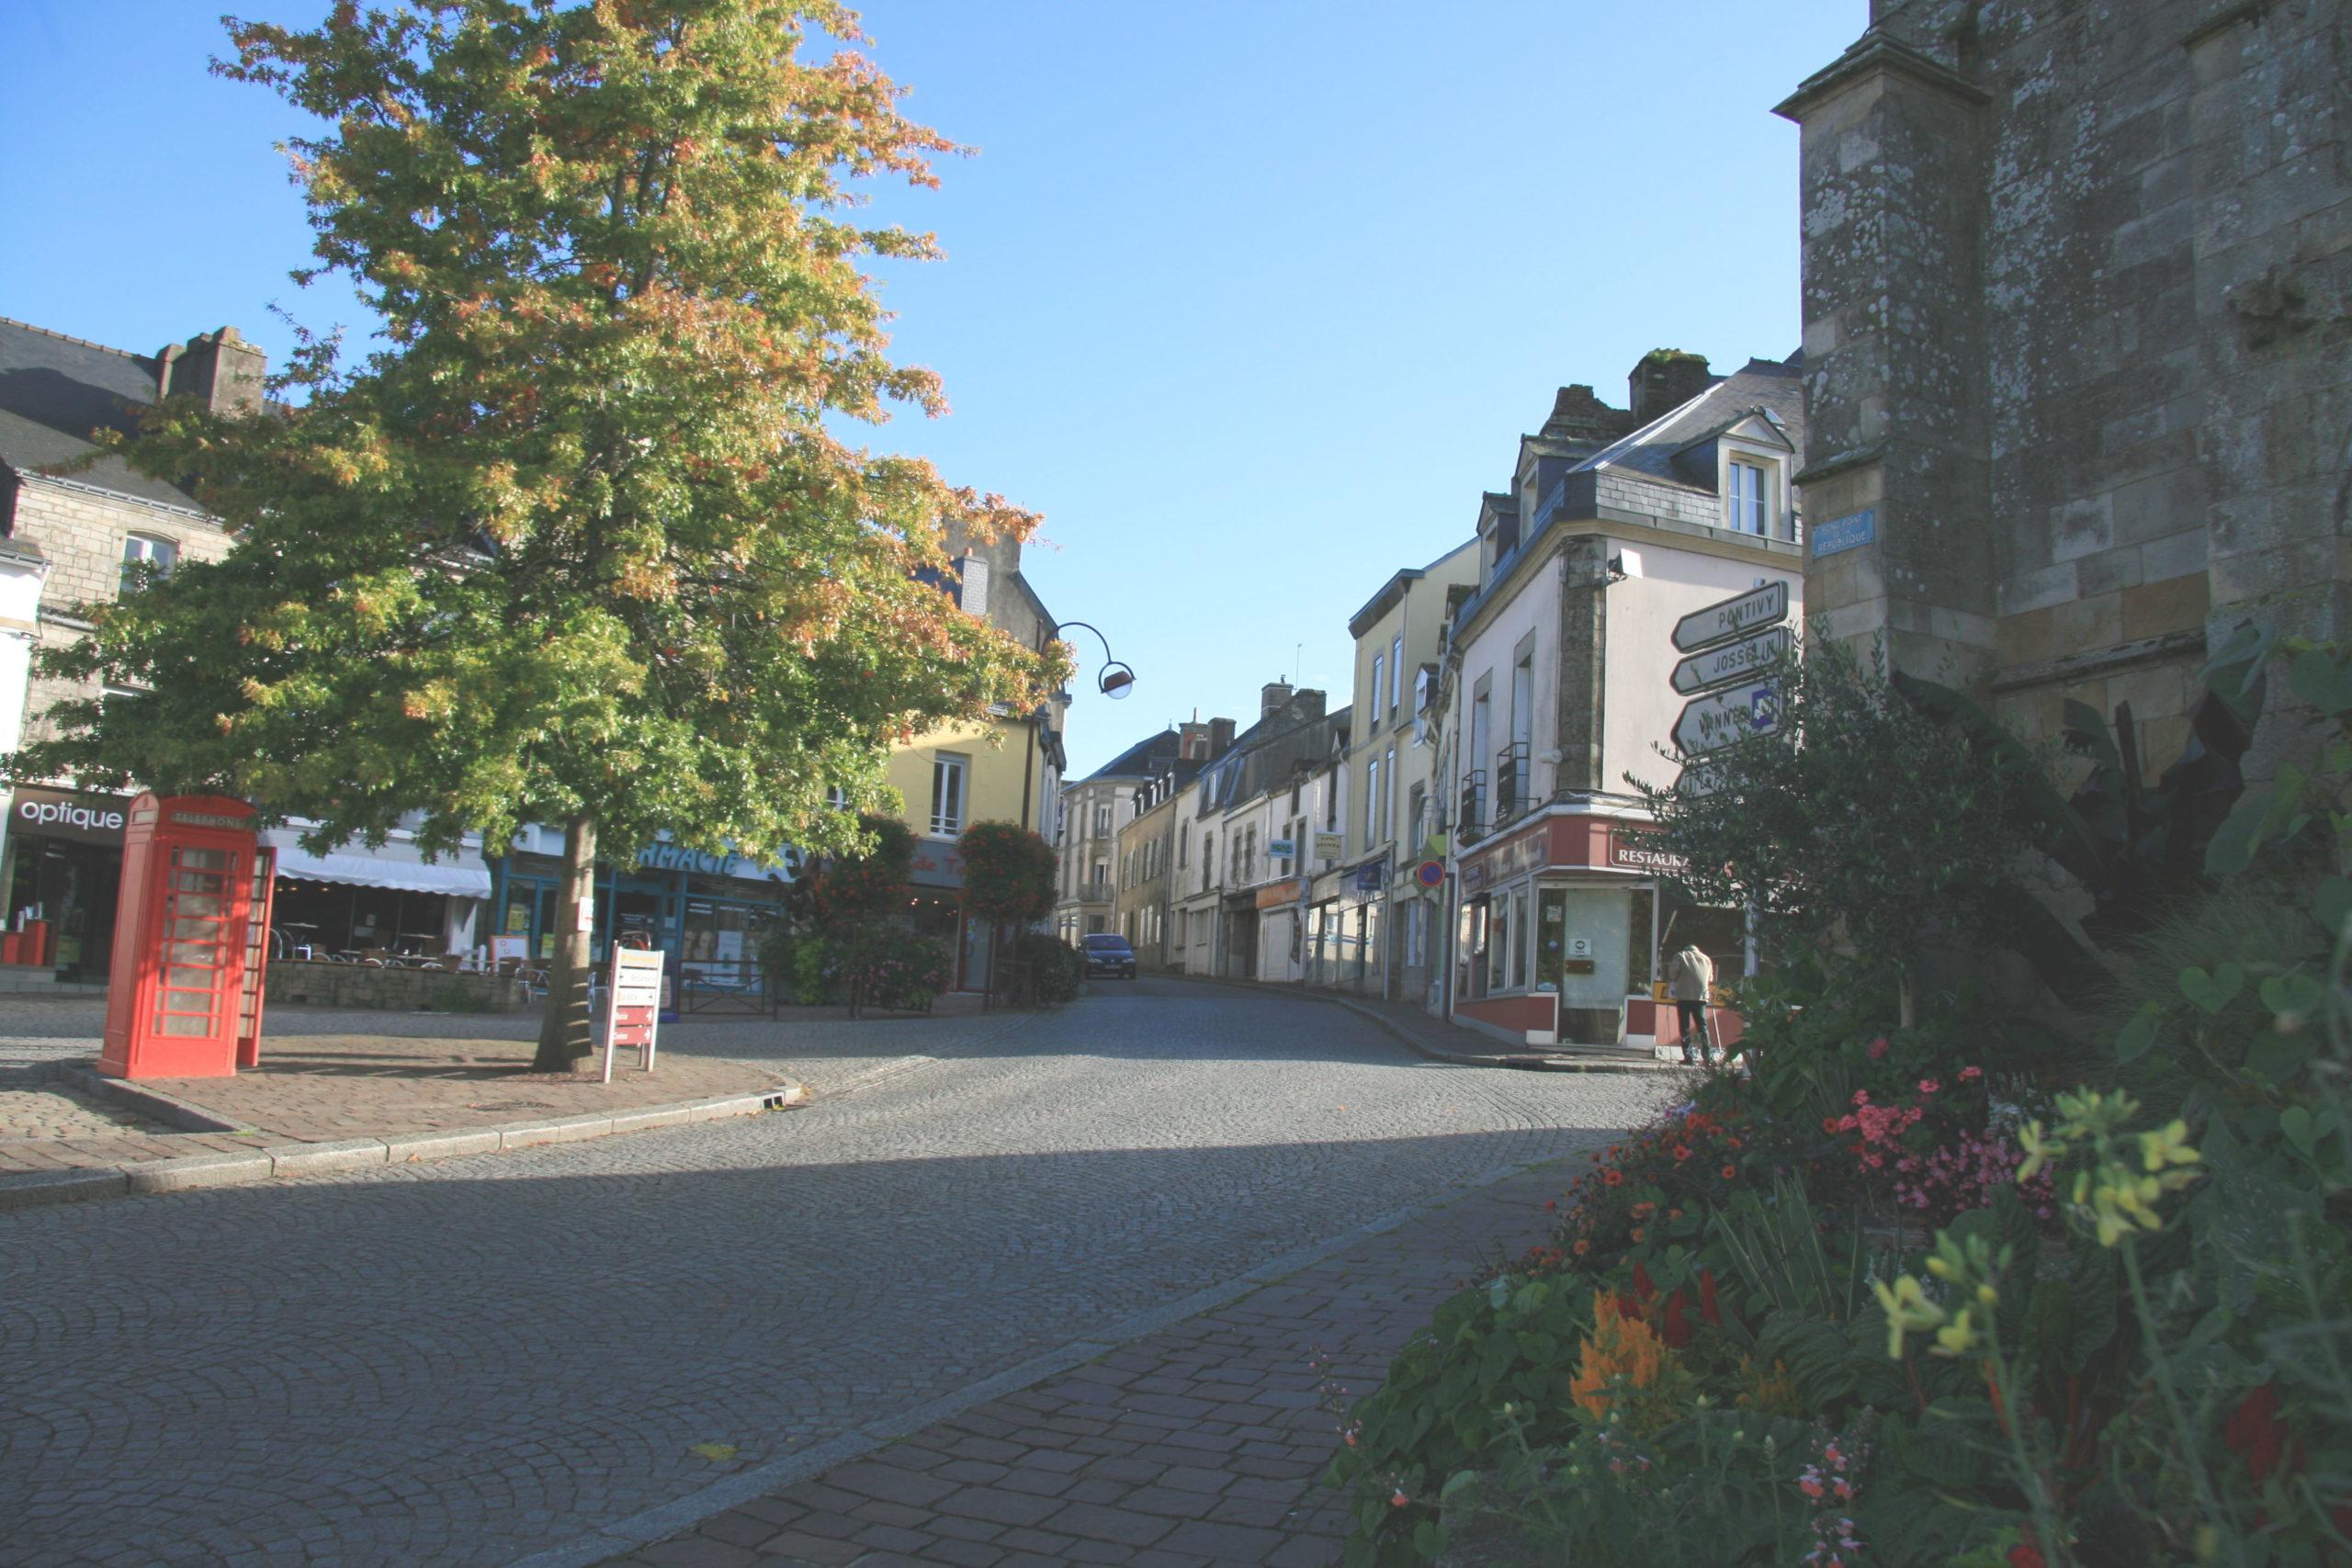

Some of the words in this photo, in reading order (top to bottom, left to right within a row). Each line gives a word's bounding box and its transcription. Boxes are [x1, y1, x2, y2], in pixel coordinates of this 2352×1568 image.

[1718, 593, 1774, 629] PONTIVY
[1713, 638, 1777, 673] JOSSELIN
[1699, 705, 1746, 735] VNN
[20, 801, 123, 830] optique
[639, 840, 740, 874] RMACIE
[1618, 849, 1691, 867] RESTAURA
